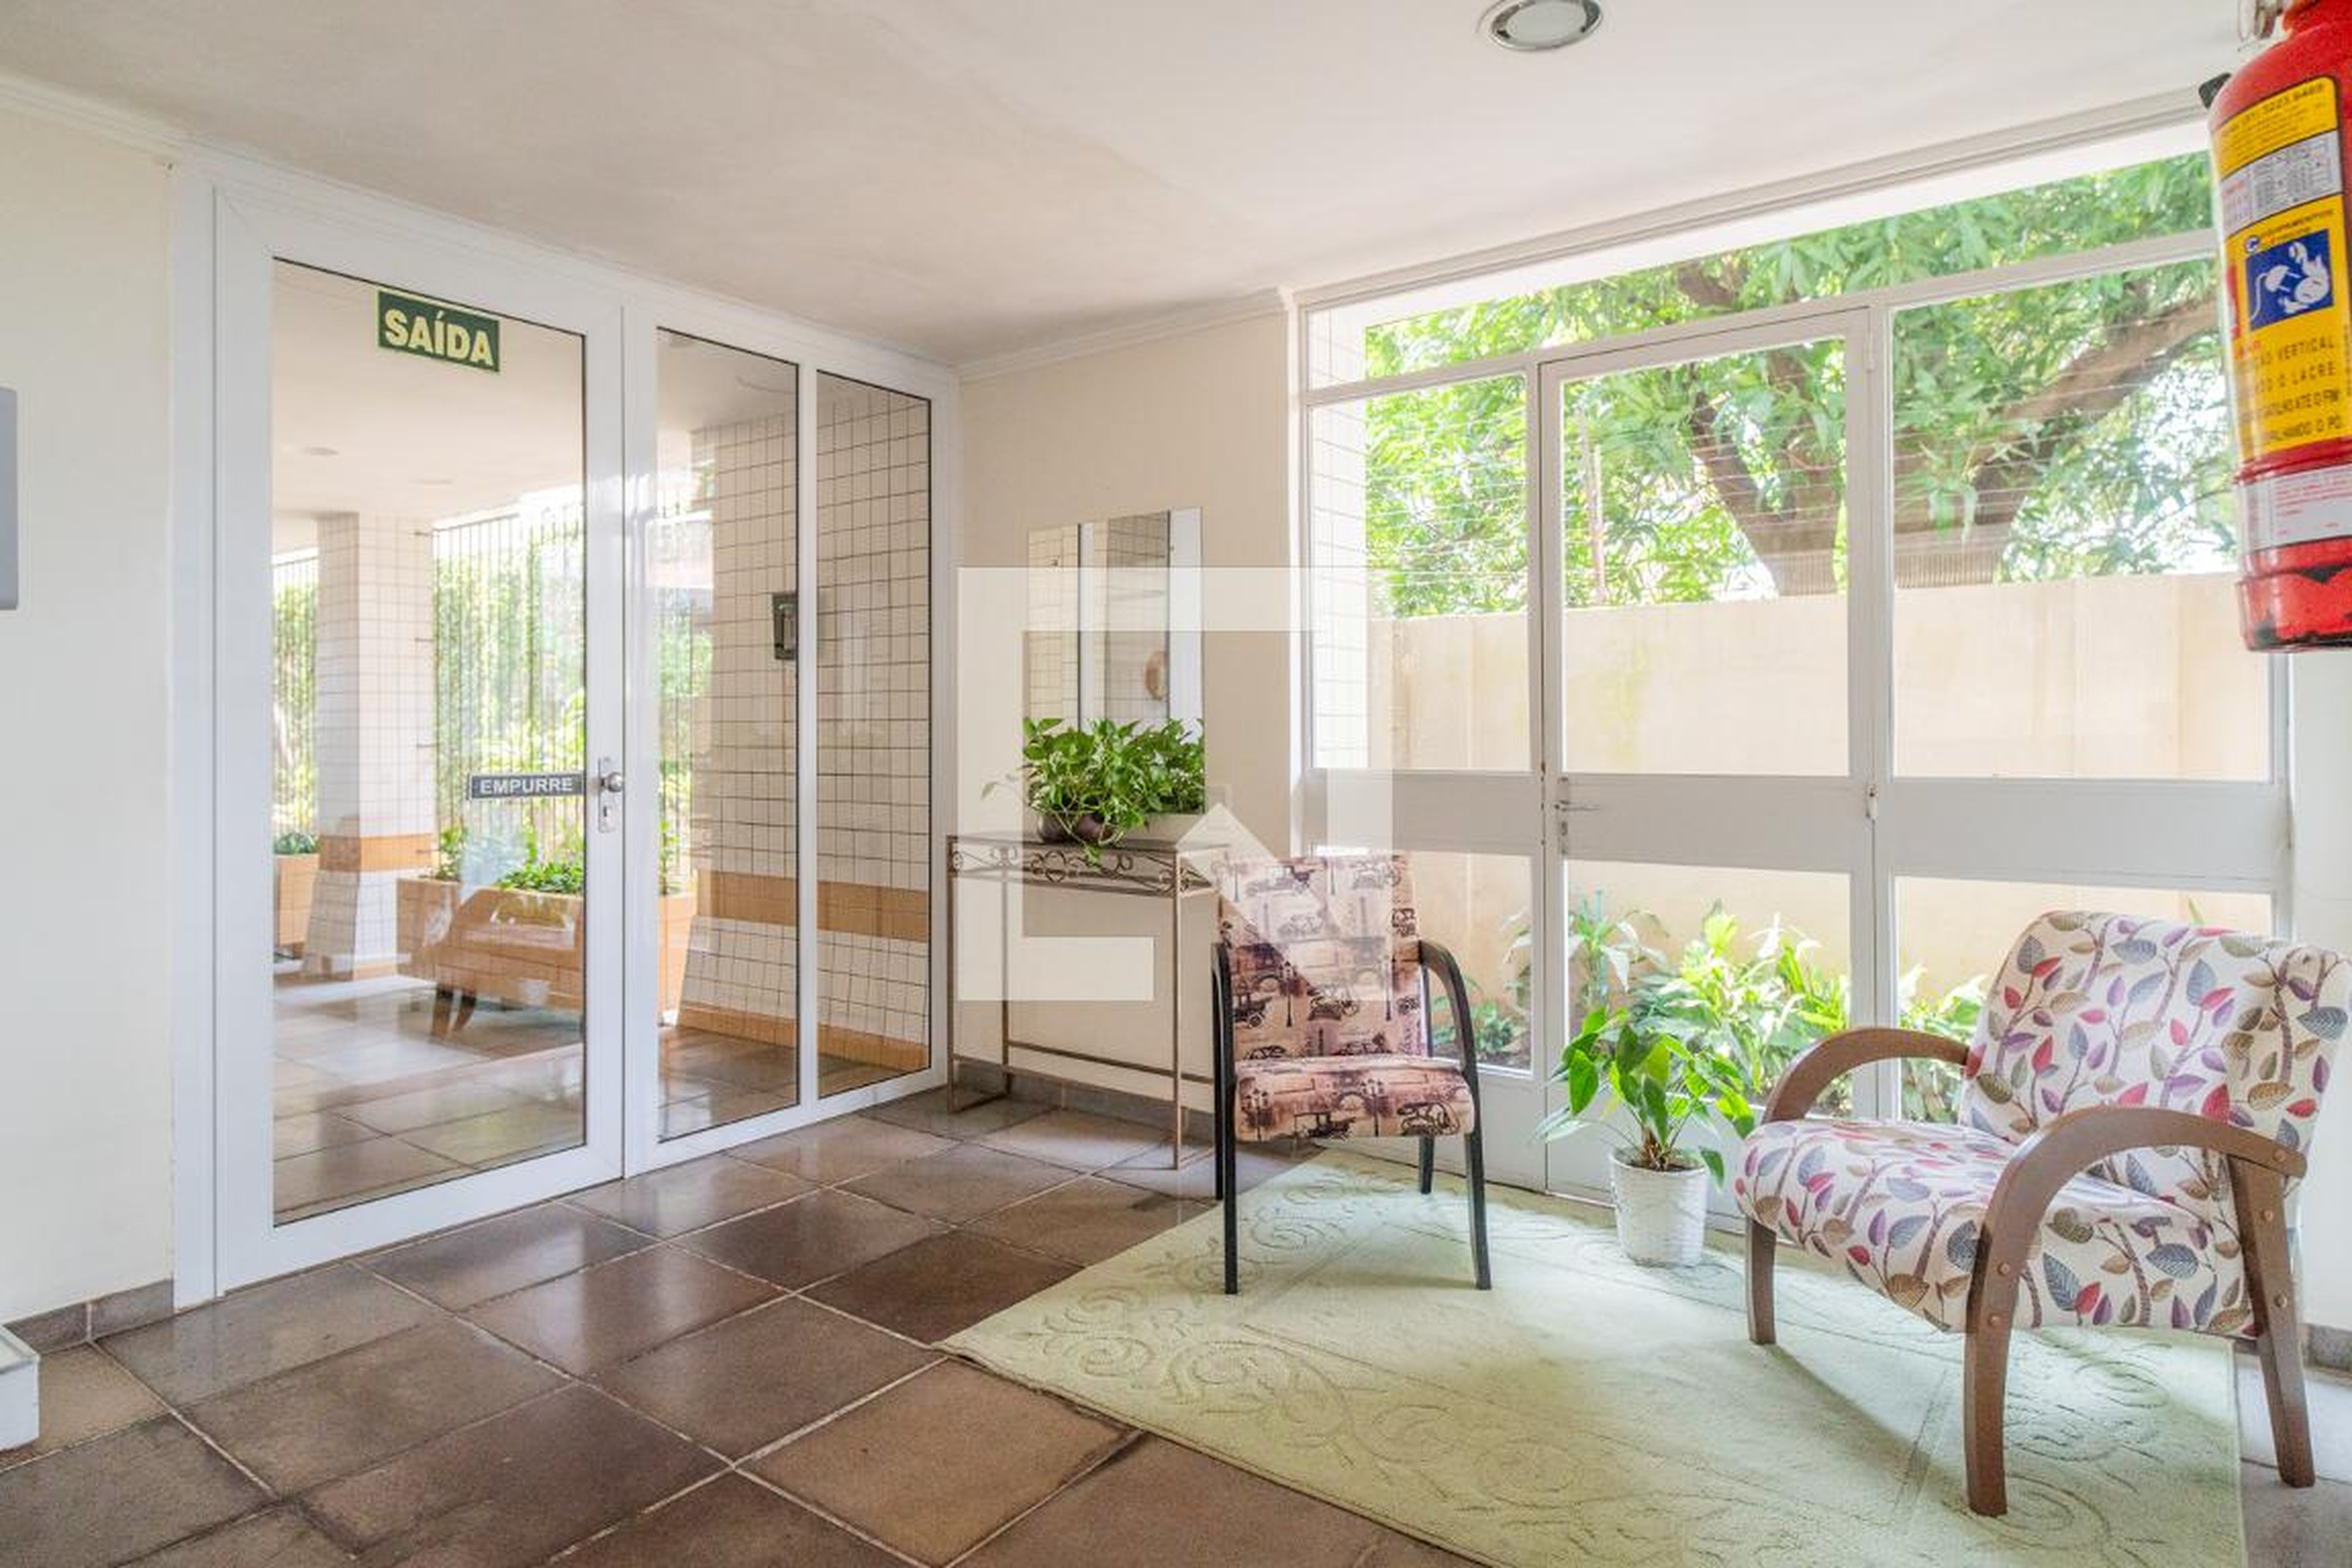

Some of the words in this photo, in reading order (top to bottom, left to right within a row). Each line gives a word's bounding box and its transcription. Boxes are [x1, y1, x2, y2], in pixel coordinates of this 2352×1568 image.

[385, 309, 494, 367] SAÍDA
[2278, 336, 2335, 360] VERTICAL
[2291, 360, 2337, 386] LACRE
[480, 777, 573, 794] EMPURRE
